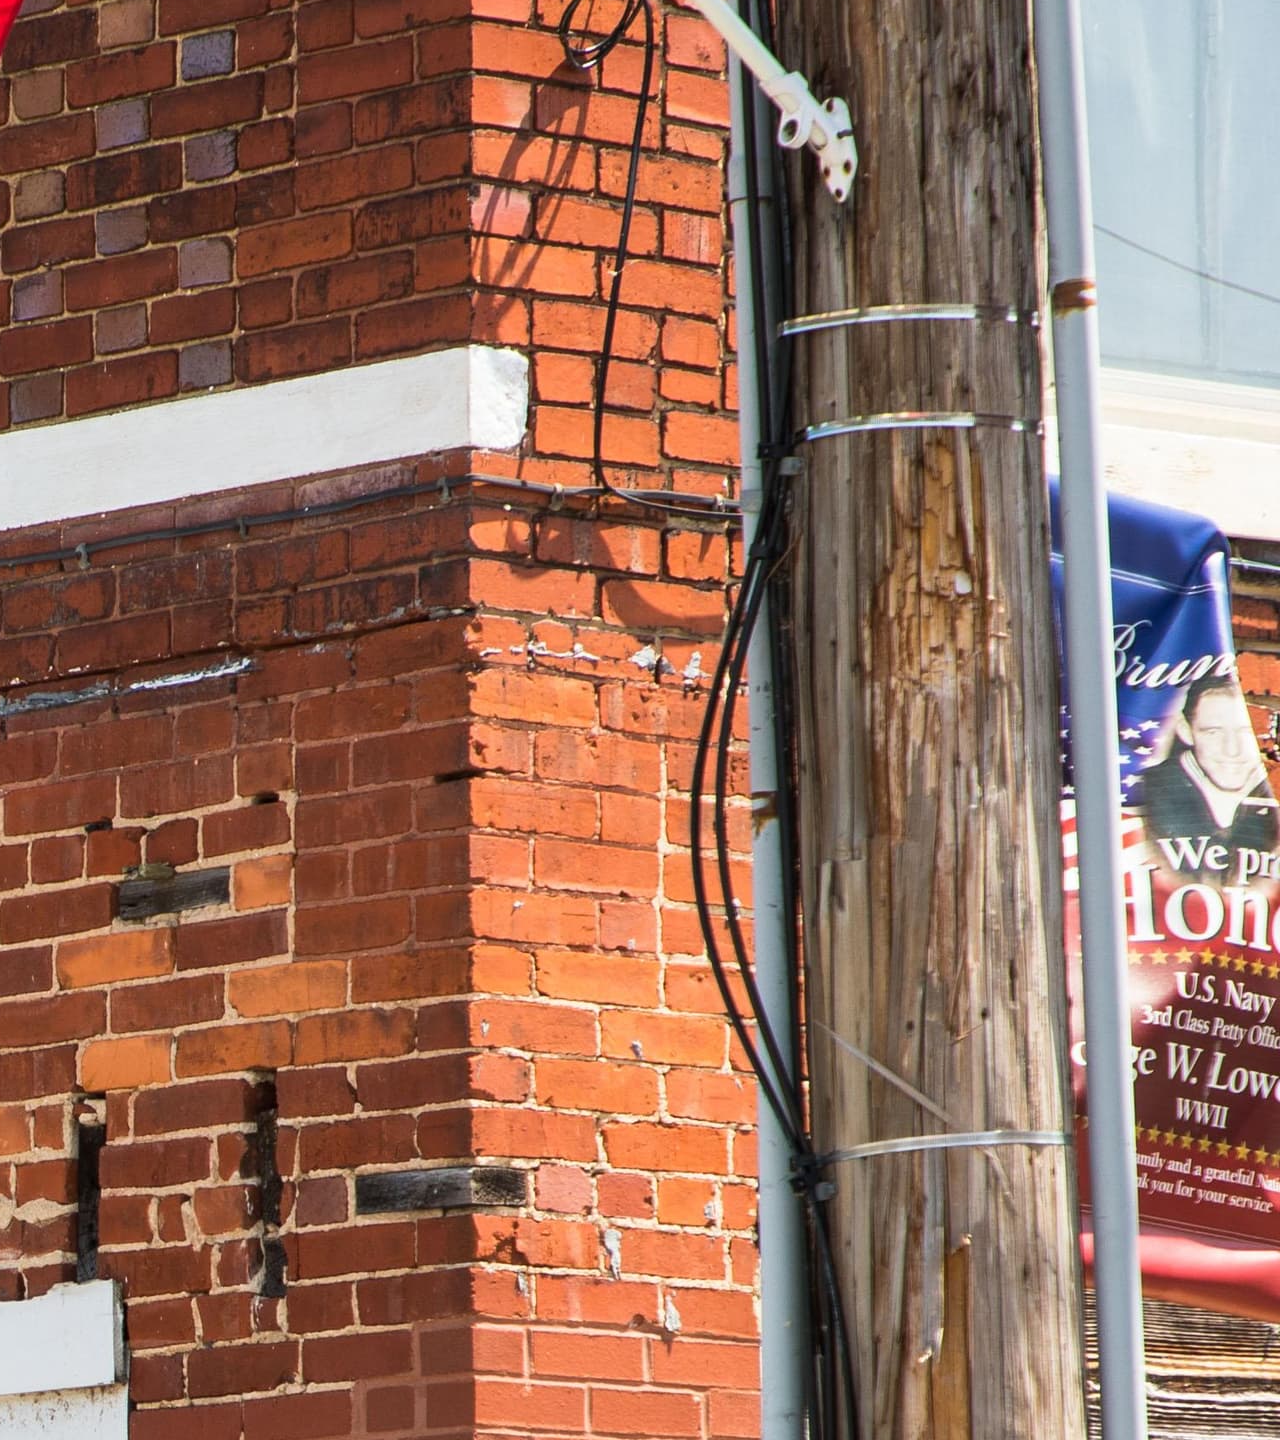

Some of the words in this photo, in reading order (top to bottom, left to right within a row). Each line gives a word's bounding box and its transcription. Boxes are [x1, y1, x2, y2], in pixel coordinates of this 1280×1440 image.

[1155, 835, 1229, 871] We
[1173, 971, 1219, 1004] U.S.
[1224, 979, 1277, 1023] Navy
[1140, 1004, 1173, 1026] 3rd
[1174, 1009, 1211, 1034] Class
[1211, 1017, 1248, 1047] Petty
[1166, 1041, 1204, 1084] W.
[1207, 1051, 1280, 1102] Low
[1175, 1097, 1229, 1129] WWII
[1167, 1158, 1193, 1175] and
[1193, 1164, 1202, 1177] a
[1202, 1167, 1256, 1187] grateful
[1151, 1179, 1174, 1195] you
[1175, 1179, 1195, 1198] for
[1196, 1187, 1228, 1204] your
[1229, 1194, 1274, 1214] service
